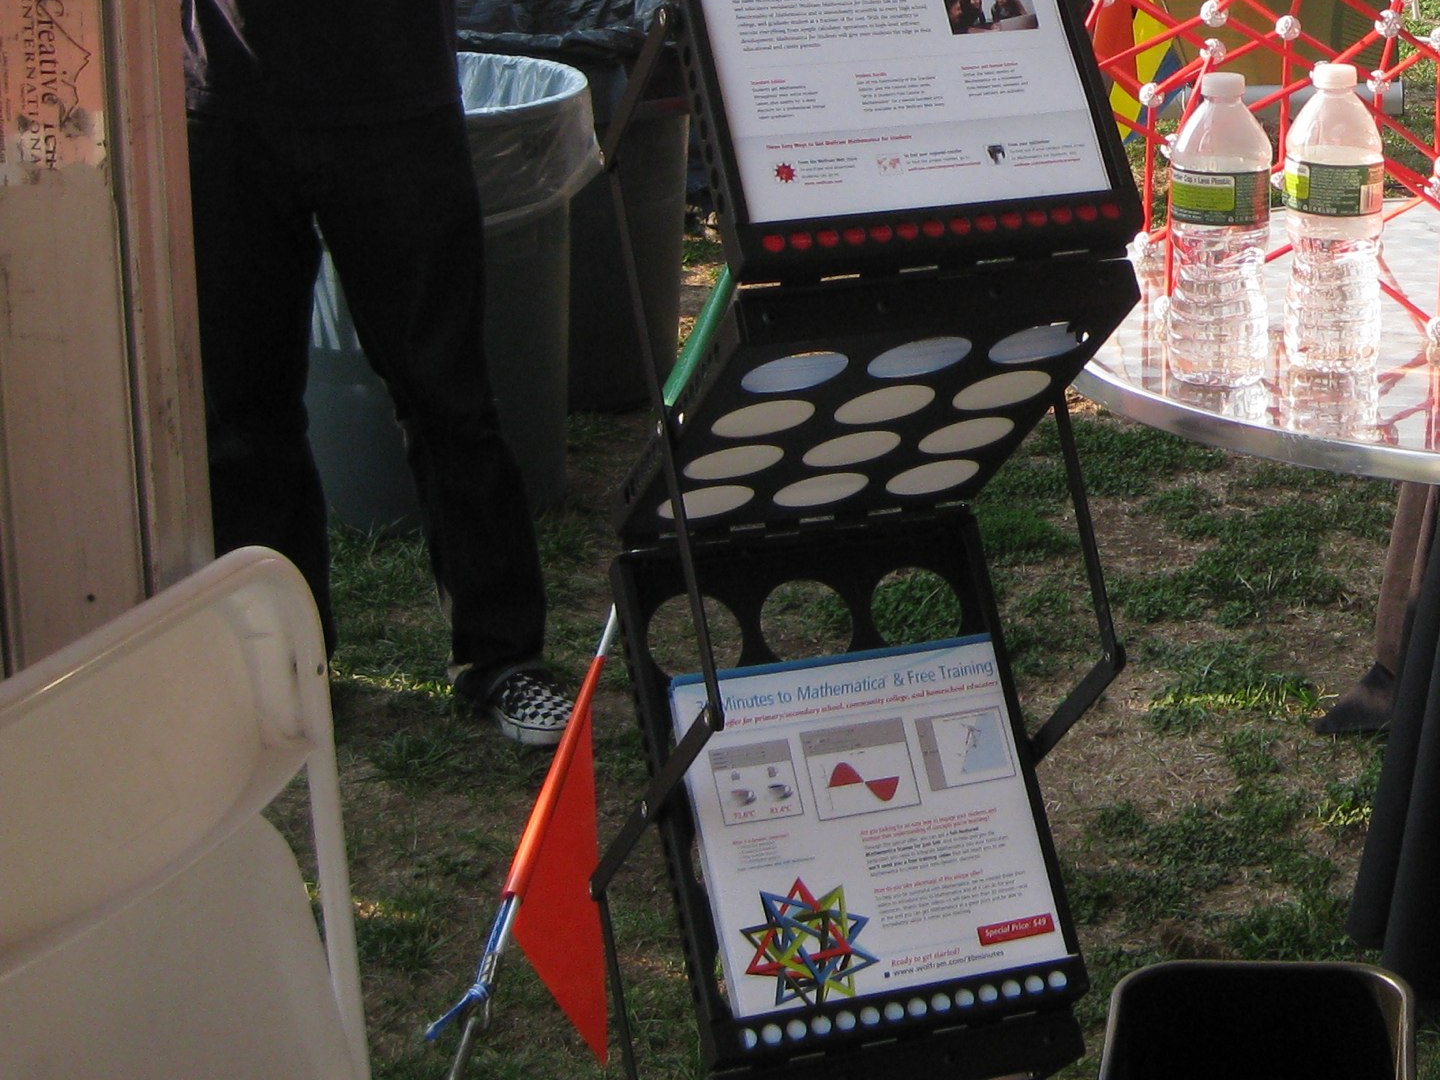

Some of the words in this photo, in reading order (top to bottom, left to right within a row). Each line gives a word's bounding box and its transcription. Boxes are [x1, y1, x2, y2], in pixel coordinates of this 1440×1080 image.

[722, 694, 774, 712] Minutes
[777, 691, 792, 703] to
[797, 677, 885, 701] Mathematica
[894, 673, 905, 687] &
[908, 670, 936, 685] Free
[938, 661, 994, 680] Training
[985, 925, 1010, 938] Special
[1011, 921, 1031, 931] Price:
[891, 955, 913, 967] Ready
[914, 954, 922, 962] to
[922, 953, 933, 964] get
